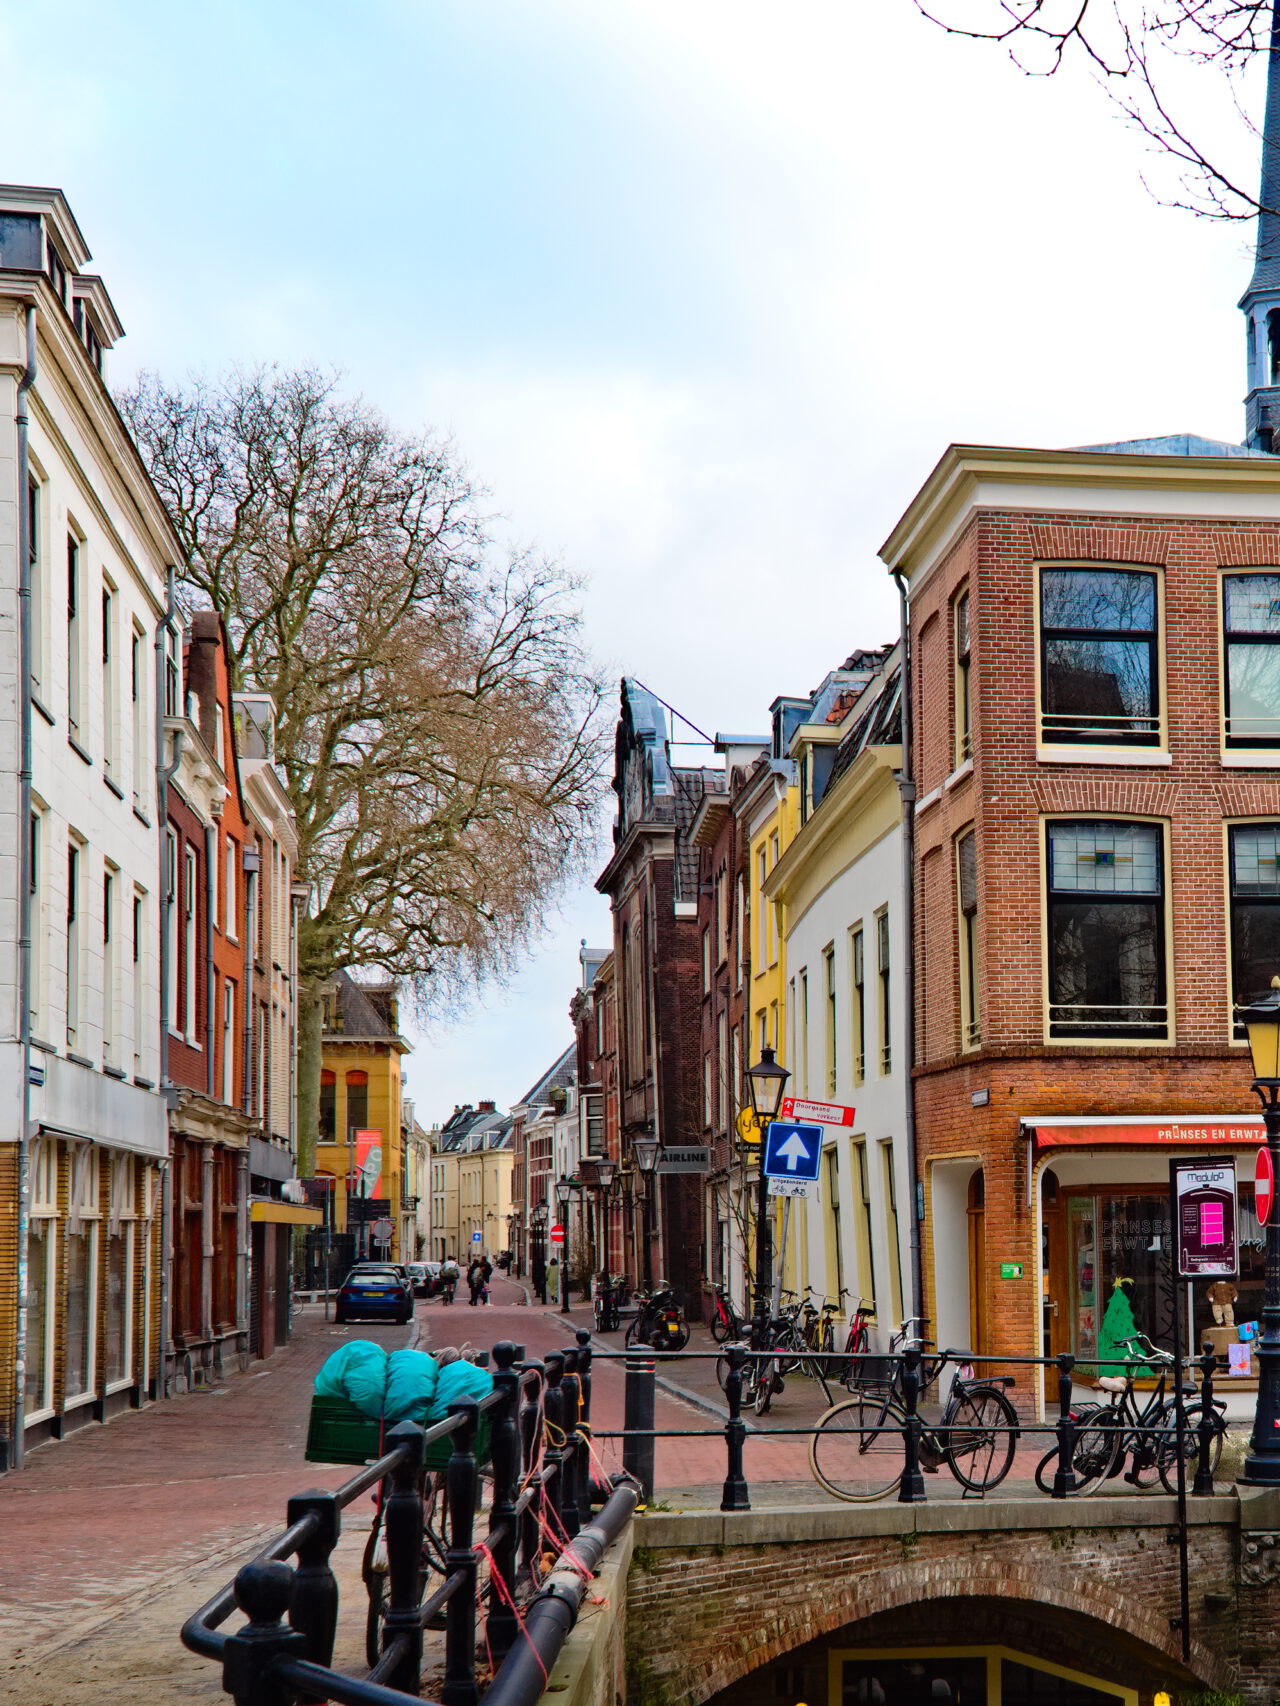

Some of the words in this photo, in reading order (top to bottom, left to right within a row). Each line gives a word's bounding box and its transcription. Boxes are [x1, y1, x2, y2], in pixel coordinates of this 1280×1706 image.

[1211, 1129, 1225, 1139] EN
[661, 1153, 706, 1162] AIRLINE
[1102, 1219, 1172, 1234] PRINSES
